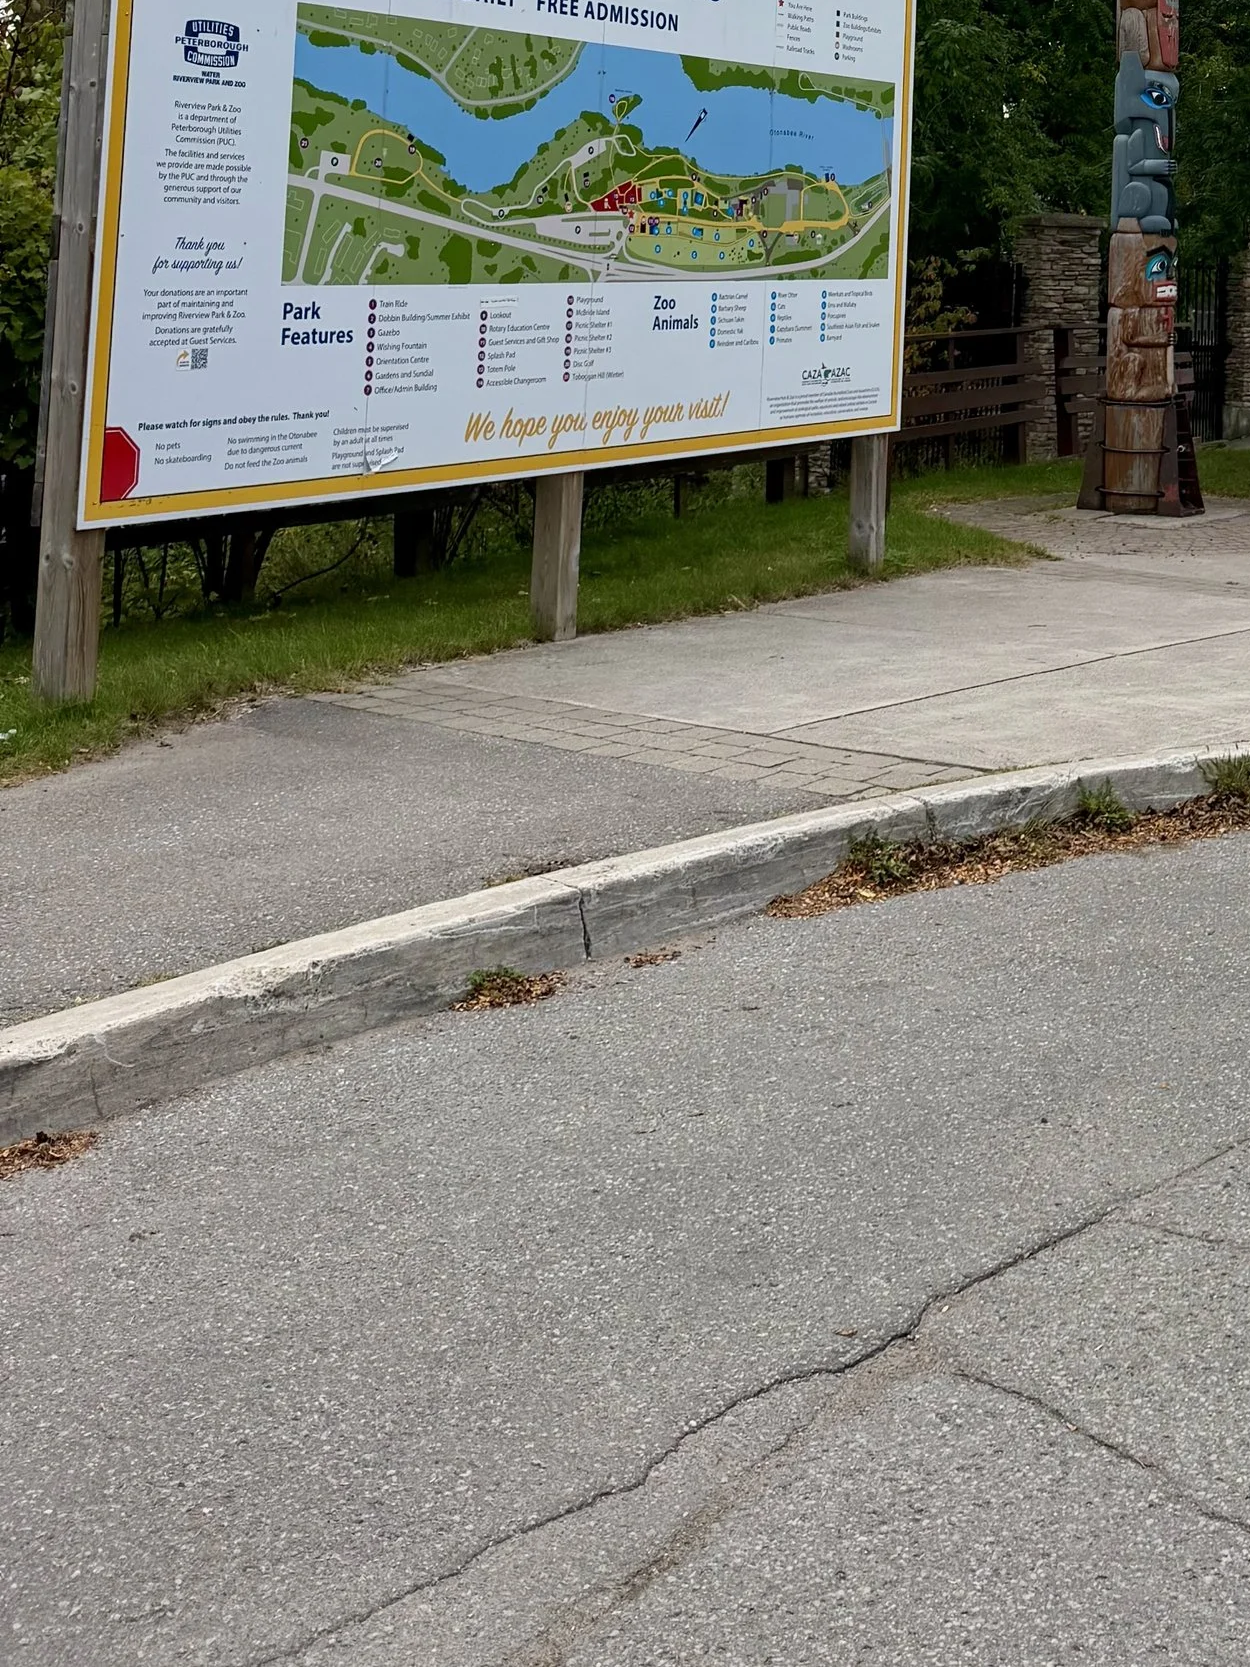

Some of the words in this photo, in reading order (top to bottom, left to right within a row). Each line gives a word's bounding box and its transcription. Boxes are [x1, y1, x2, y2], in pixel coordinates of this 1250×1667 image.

[584, 0, 678, 32] ADMISSION
[192, 21, 234, 36] UTILITIES
[175, 36, 248, 52] PETERBOROUGH
[187, 51, 235, 66] COMMISSION
[173, 75, 204, 84] RIVERVIEW
[175, 101, 206, 110] Riverview
[229, 105, 241, 113] Zoo
[190, 114, 228, 124] department
[172, 123, 216, 134] Peterborough
[218, 127, 241, 135] Utilities
[175, 135, 215, 144] Commission
[178, 150, 204, 159] facilities
[168, 161, 193, 169] provide
[226, 164, 251, 173] possible
[159, 172, 167, 181] by
[210, 174, 236, 184] through
[196, 186, 221, 194] support
[164, 196, 201, 205] community
[175, 236, 204, 250] Thank
[204, 241, 225, 256] you
[152, 256, 169, 274] for
[171, 258, 223, 275] supporting
[226, 257, 243, 269] us!
[216, 289, 248, 297] important
[181, 300, 220, 309] maintaining
[653, 295, 676, 310] Zoo
[142, 312, 177, 321] improving
[178, 311, 210, 320] Riverview
[212, 311, 225, 319] Park
[283, 301, 321, 320] Park
[652, 314, 699, 331] Animals
[155, 326, 189, 334] Donations
[202, 325, 233, 335] gratefully
[281, 327, 353, 345] Features
[149, 338, 180, 347] accepted
[189, 337, 208, 345] Guest
[377, 342, 400, 352] Wishing
[376, 357, 409, 365] Orientation
[375, 371, 399, 380] Gardens
[400, 370, 412, 378] and
[413, 369, 434, 377] Sundial
[802, 369, 822, 380] CAZA
[831, 367, 850, 377] AZAC
[138, 422, 163, 431] Please
[165, 420, 188, 429] watch
[190, 419, 200, 427] for
[202, 418, 221, 428] signs
[223, 416, 237, 425] and
[238, 415, 256, 424] obey
[258, 414, 269, 422] the
[293, 411, 313, 420] Thank
[315, 410, 329, 420] you!
[464, 410, 495, 443] We
[499, 407, 547, 447] hope
[548, 413, 587, 450] you
[592, 405, 640, 446] enjoy
[640, 401, 684, 439] your
[688, 390, 730, 420] visit!
[167, 442, 180, 451] pets
[248, 446, 280, 454] dangerous
[165, 454, 212, 464] skateboarding
[285, 456, 308, 464] animals
